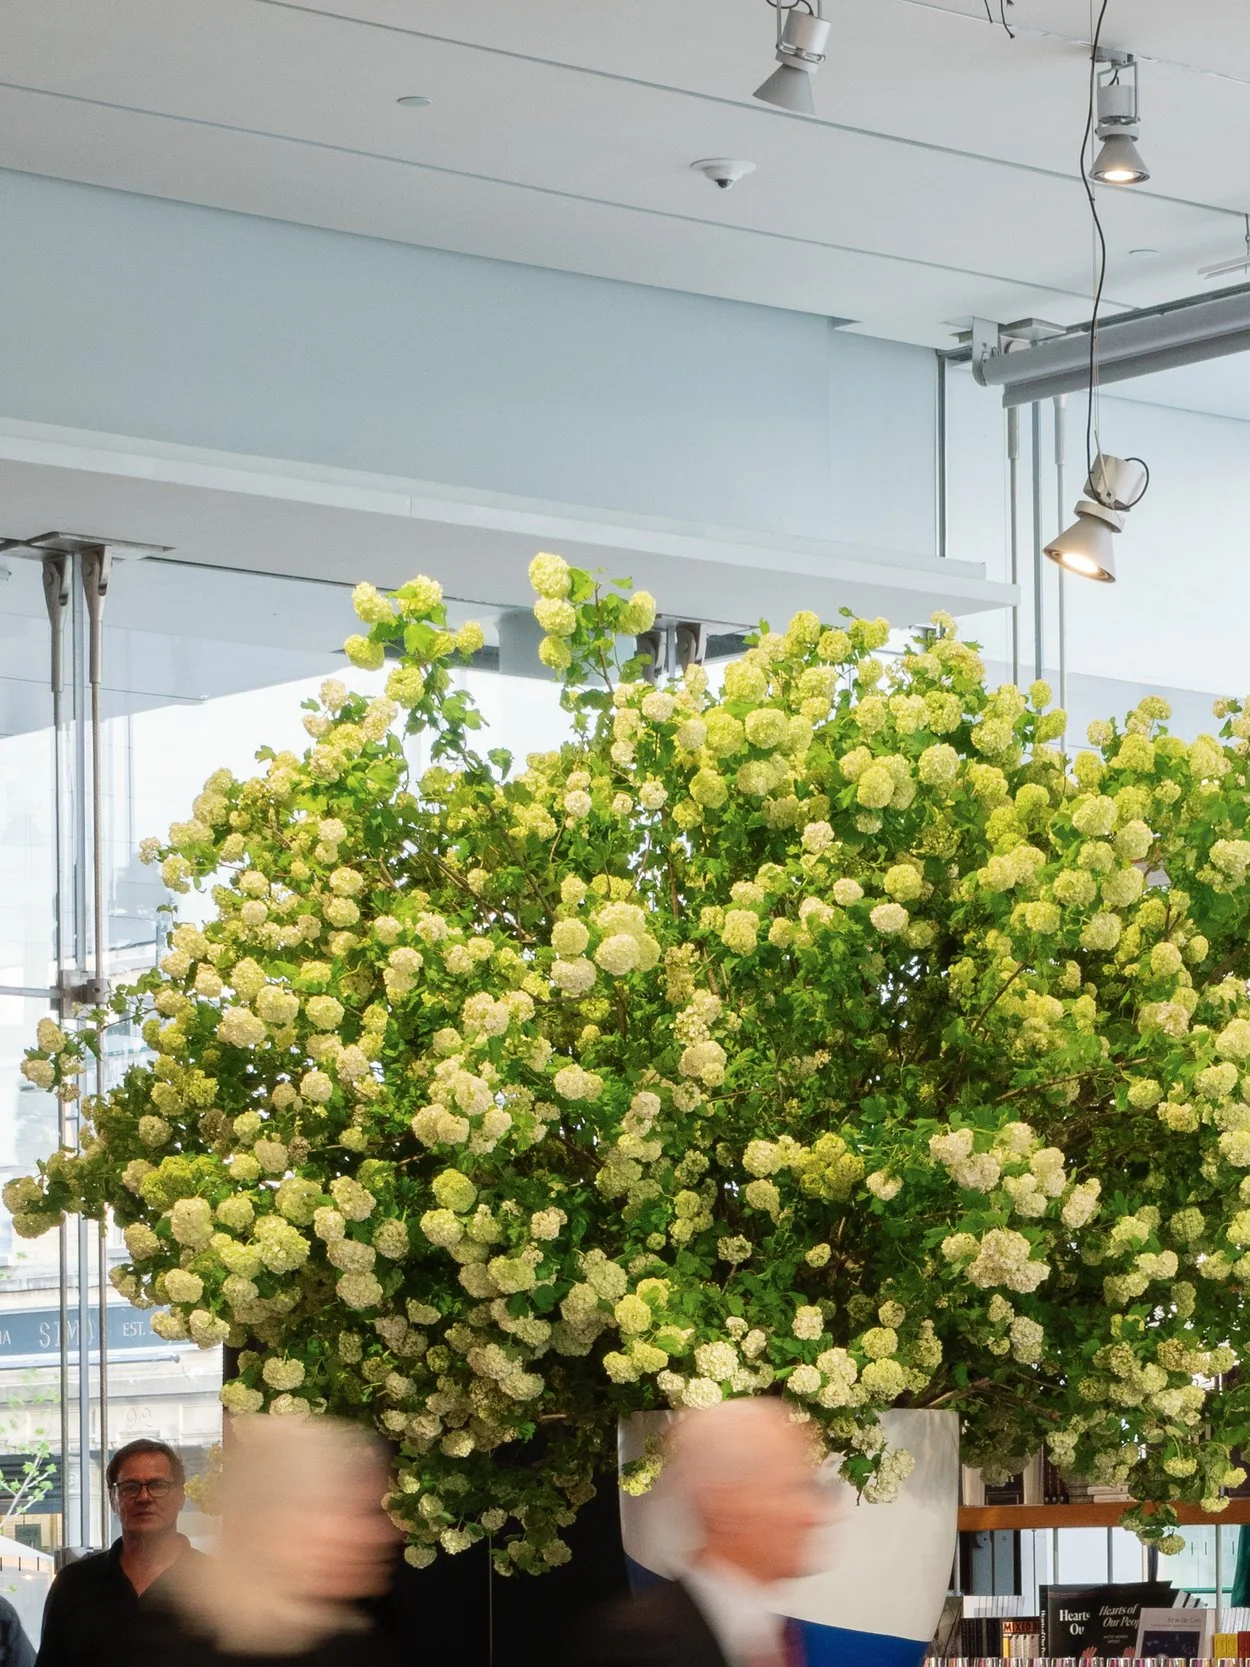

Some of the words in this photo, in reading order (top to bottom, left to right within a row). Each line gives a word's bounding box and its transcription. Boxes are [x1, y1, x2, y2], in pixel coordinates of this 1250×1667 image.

[123, 1321, 146, 1337] EST.
[1059, 1609, 1090, 1622] Hearts
[1099, 1606, 1126, 1617] Hearts
[1126, 1603, 1138, 1615] of
[1103, 1617, 1121, 1628] Our
